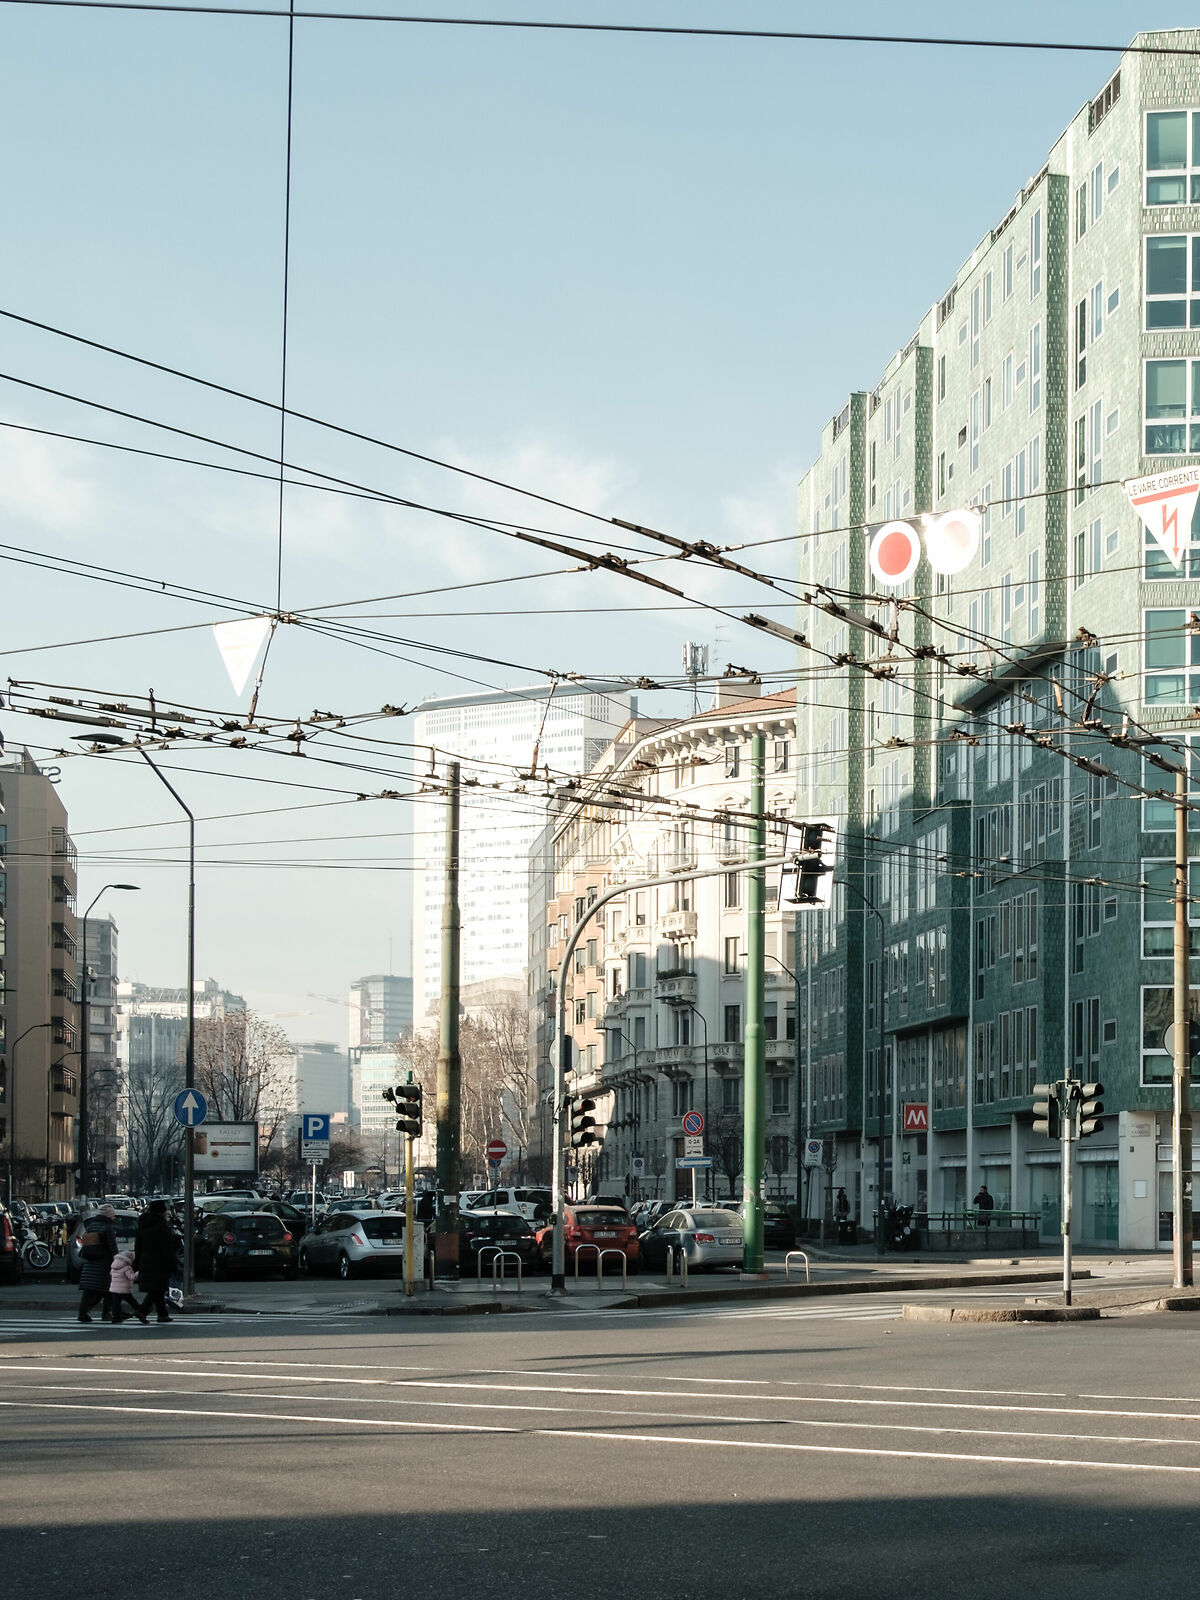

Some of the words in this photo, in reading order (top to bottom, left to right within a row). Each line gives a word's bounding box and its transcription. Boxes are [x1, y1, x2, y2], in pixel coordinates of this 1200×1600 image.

[1128, 480, 1157, 497] LEVARE
[1158, 470, 1200, 489] CORRENTE
[308, 1117, 324, 1137] P
[906, 1109, 927, 1126] M
